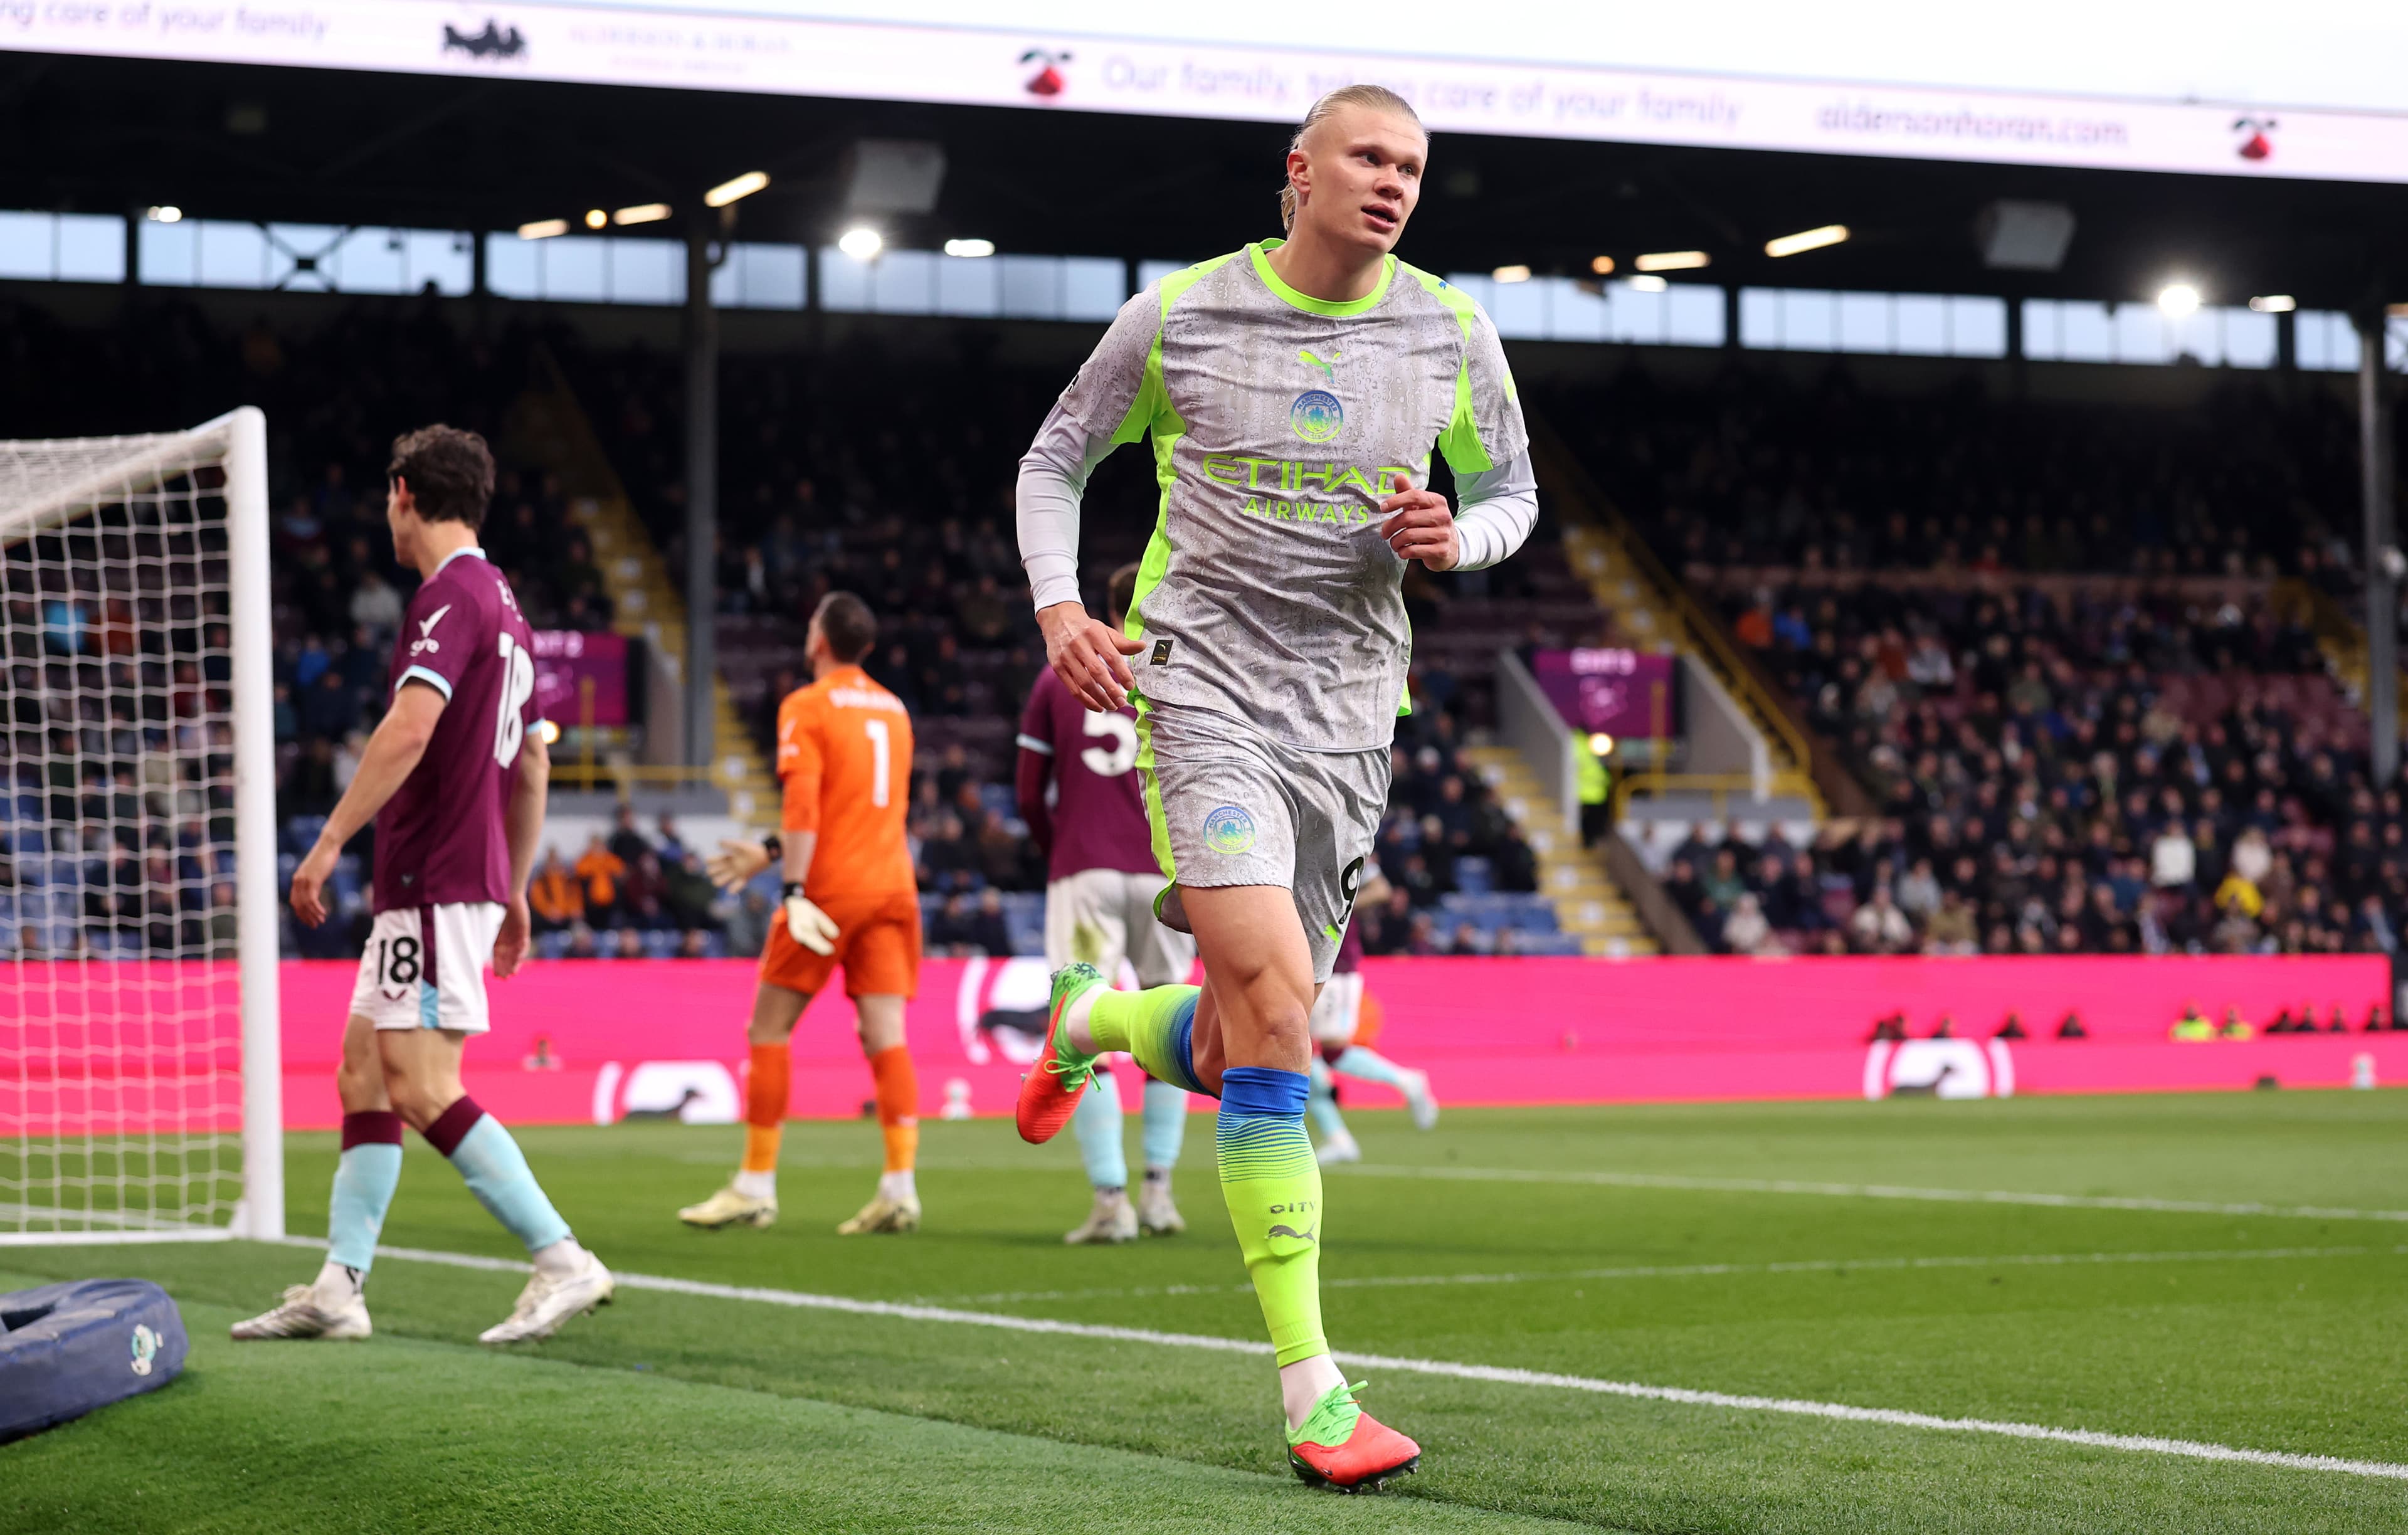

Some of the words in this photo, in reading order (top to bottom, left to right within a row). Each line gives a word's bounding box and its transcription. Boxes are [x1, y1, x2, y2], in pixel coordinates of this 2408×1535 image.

[1102, 55, 1169, 93] Our
[1423, 82, 1498, 113] care
[1554, 89, 1628, 125] your
[1638, 86, 1743, 132] family
[1297, 395, 1337, 411] MANCHESTER
[1203, 454, 1410, 494] ETIHAD
[1244, 497, 1369, 524] AIRWAYS
[494, 631, 534, 769] 18
[865, 719, 889, 808] 1
[1080, 707, 1138, 777] 5
[1208, 810, 1247, 828] MANCHESTER
[1338, 857, 1365, 924] 9
[378, 936, 418, 984] 18
